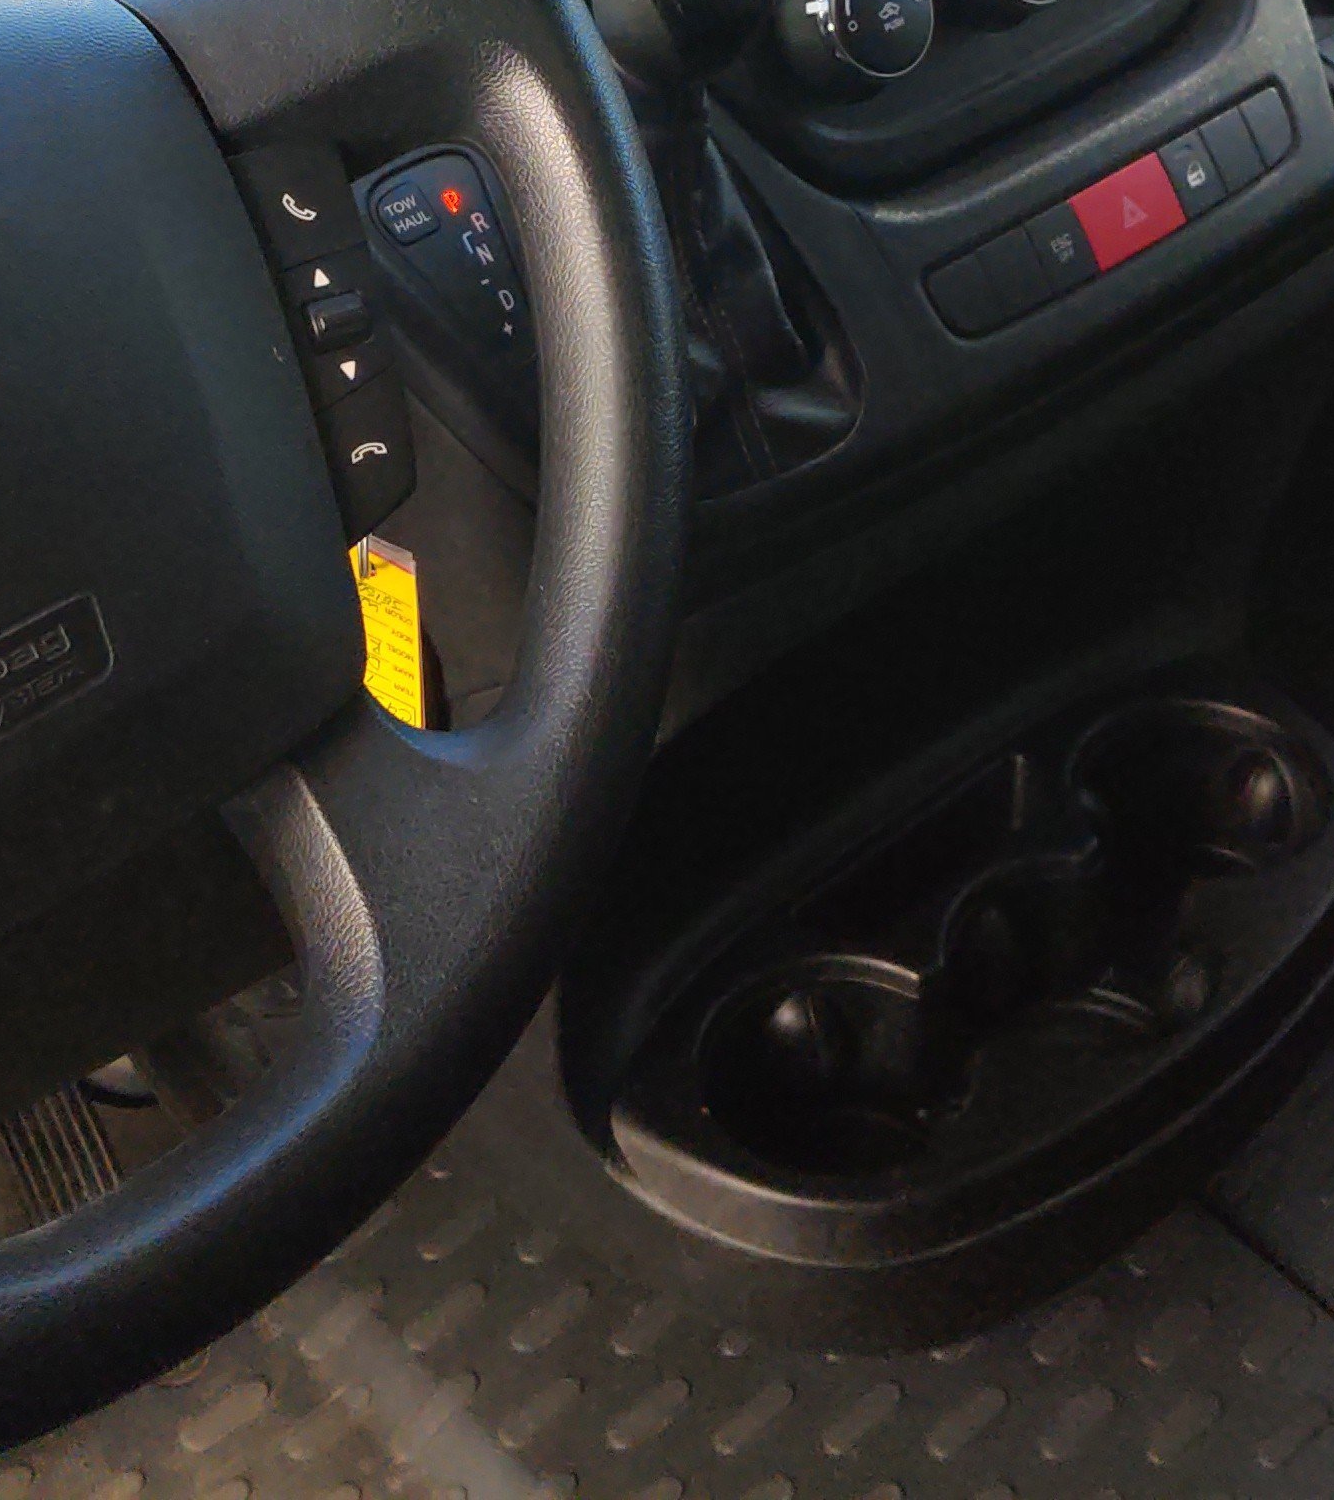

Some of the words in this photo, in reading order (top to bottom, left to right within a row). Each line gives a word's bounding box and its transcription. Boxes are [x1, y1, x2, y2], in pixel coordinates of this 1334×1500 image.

[384, 194, 417, 217] TOW
[441, 189, 462, 215] P
[393, 210, 432, 234] HAUL
[470, 212, 491, 233] R
[475, 242, 495, 266] N
[498, 289, 515, 311] D
